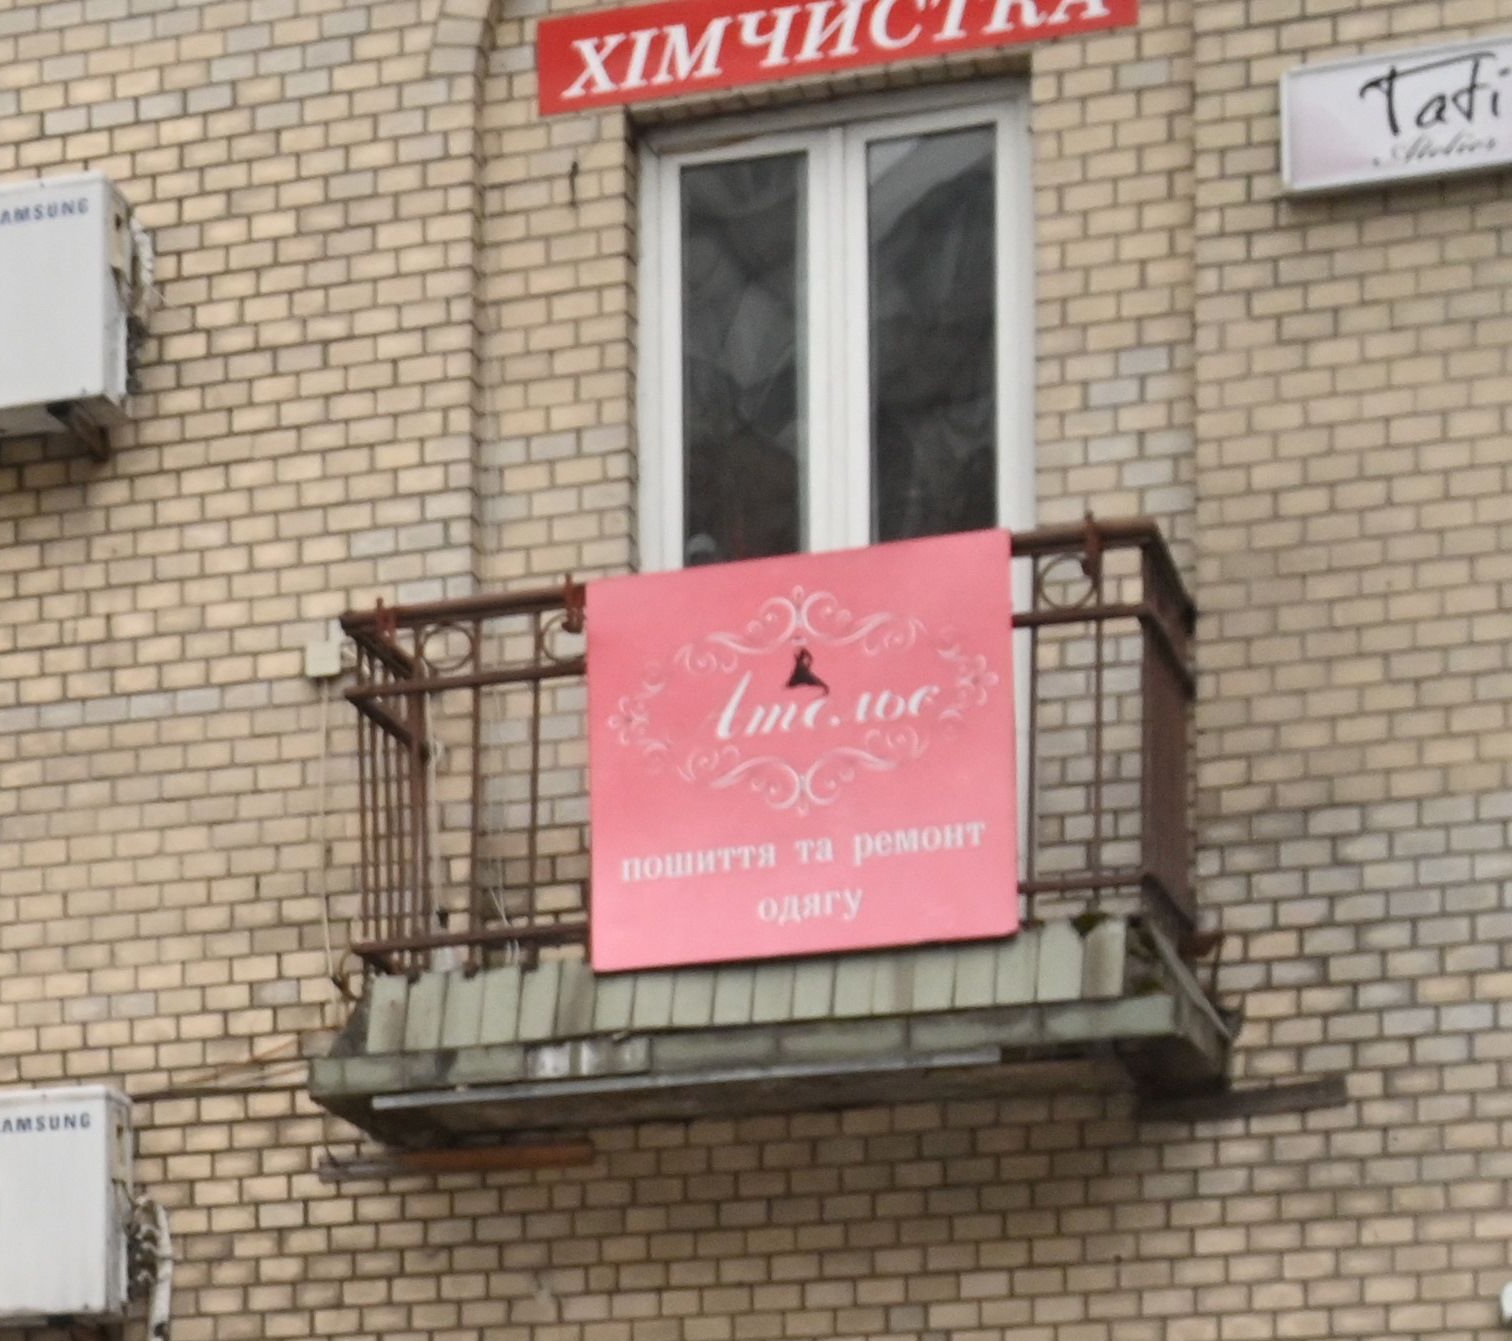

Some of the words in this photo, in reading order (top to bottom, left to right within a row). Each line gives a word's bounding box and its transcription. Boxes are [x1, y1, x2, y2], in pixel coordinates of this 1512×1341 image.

[620, 840, 777, 883] пошиття
[794, 837, 834, 867] та
[852, 820, 987, 867] ремонт
[758, 888, 864, 927] одягу
